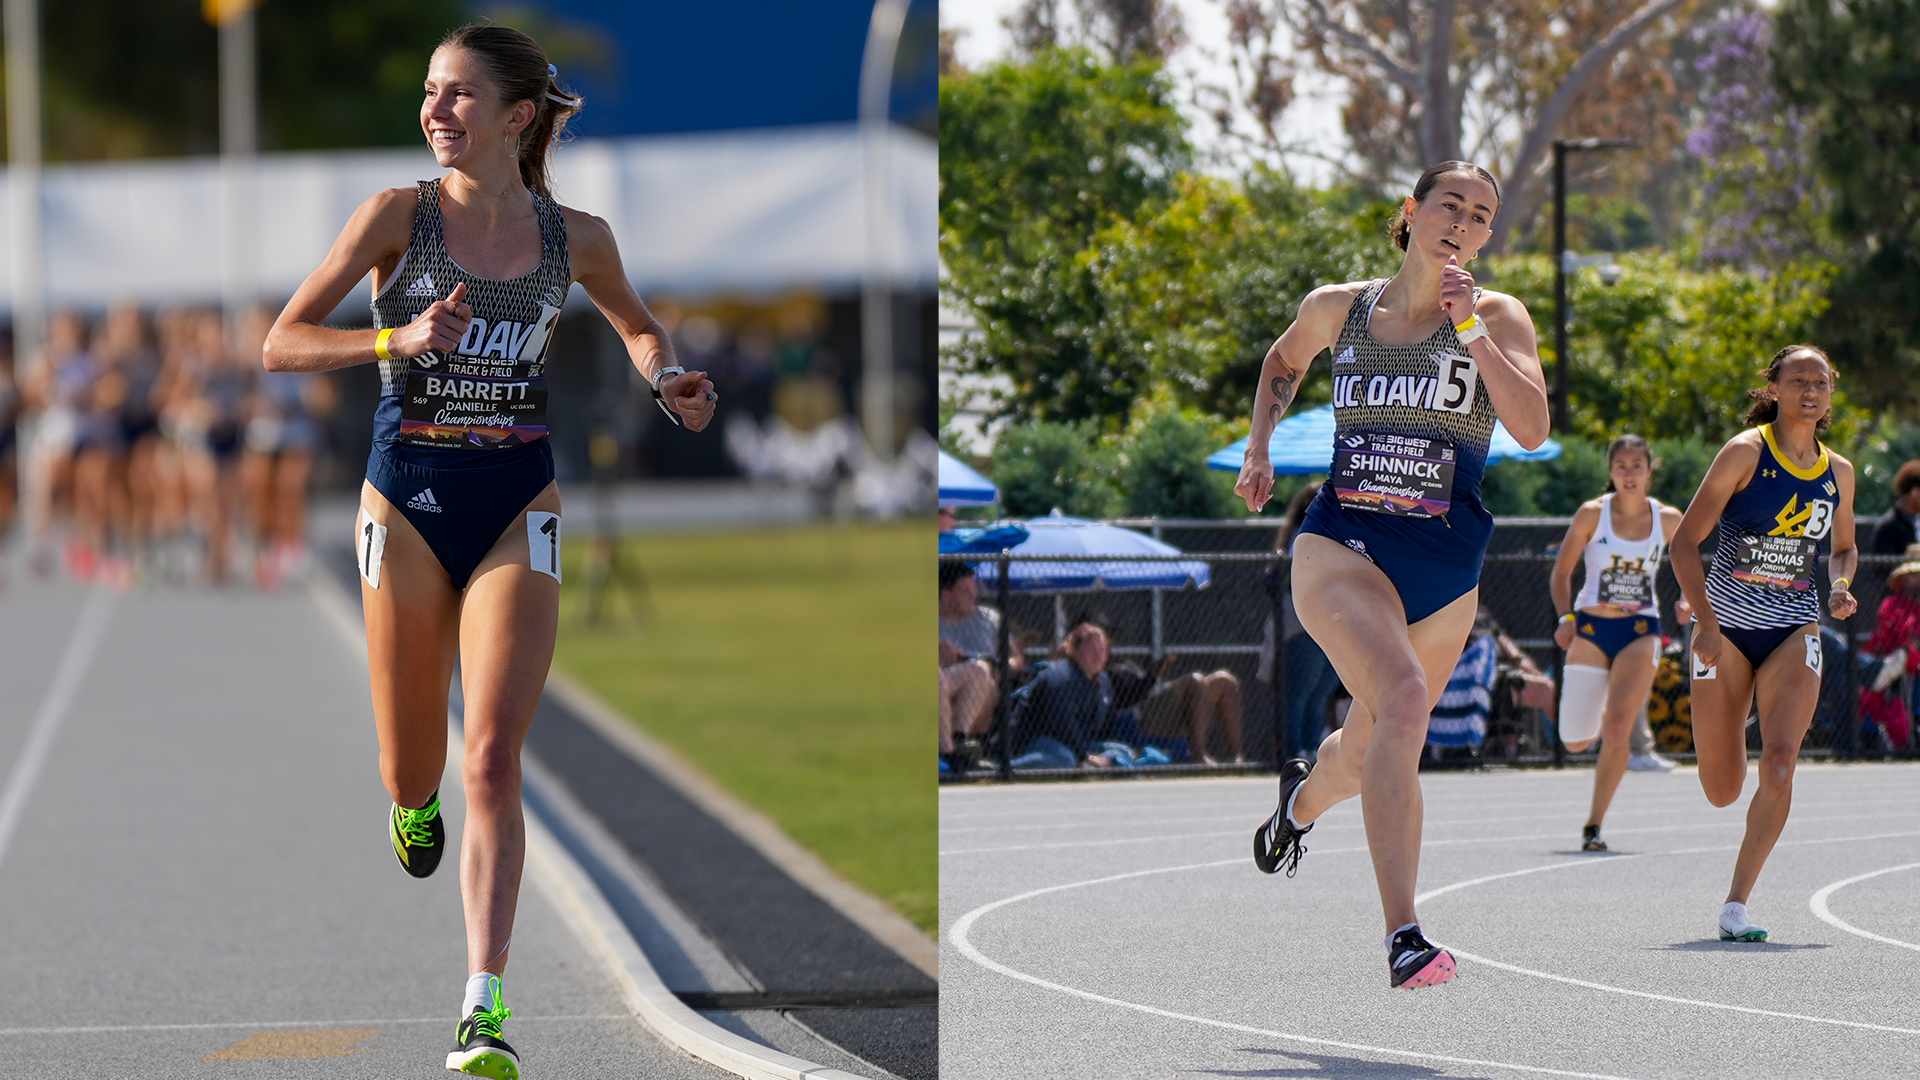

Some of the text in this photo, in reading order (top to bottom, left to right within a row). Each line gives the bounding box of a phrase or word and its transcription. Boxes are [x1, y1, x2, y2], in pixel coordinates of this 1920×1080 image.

[405, 287, 438, 297] adidas
[443, 352, 466, 363] THE
[448, 364, 512, 378] TRACK & FIELD
[426, 377, 529, 401] BARRETT
[1443, 360, 1470, 409] 5
[412, 396, 428, 405] 569
[1333, 375, 1441, 411] UC DAVI
[446, 401, 498, 412] DANIELLE
[434, 409, 515, 429] Championships
[1367, 433, 1431, 448] THE BIG WEST
[1371, 443, 1424, 457] TRACK & FIELD
[1349, 454, 1441, 480] SHINNICK
[1375, 474, 1403, 485] MAYA
[1358, 479, 1425, 500] Championships
[407, 500, 442, 513] adidas
[1809, 503, 1829, 537] 3
[365, 522, 374, 577] 1
[540, 516, 558, 575] 1
[1762, 542, 1780, 550] TRACK
[1785, 538, 1802, 547] WEST
[1649, 544, 1660, 566] 4
[1750, 548, 1804, 566] THOMAS
[1761, 563, 1786, 572] JORDYN
[1608, 584, 1643, 595] SPROCK
[1811, 637, 1821, 670] 3
